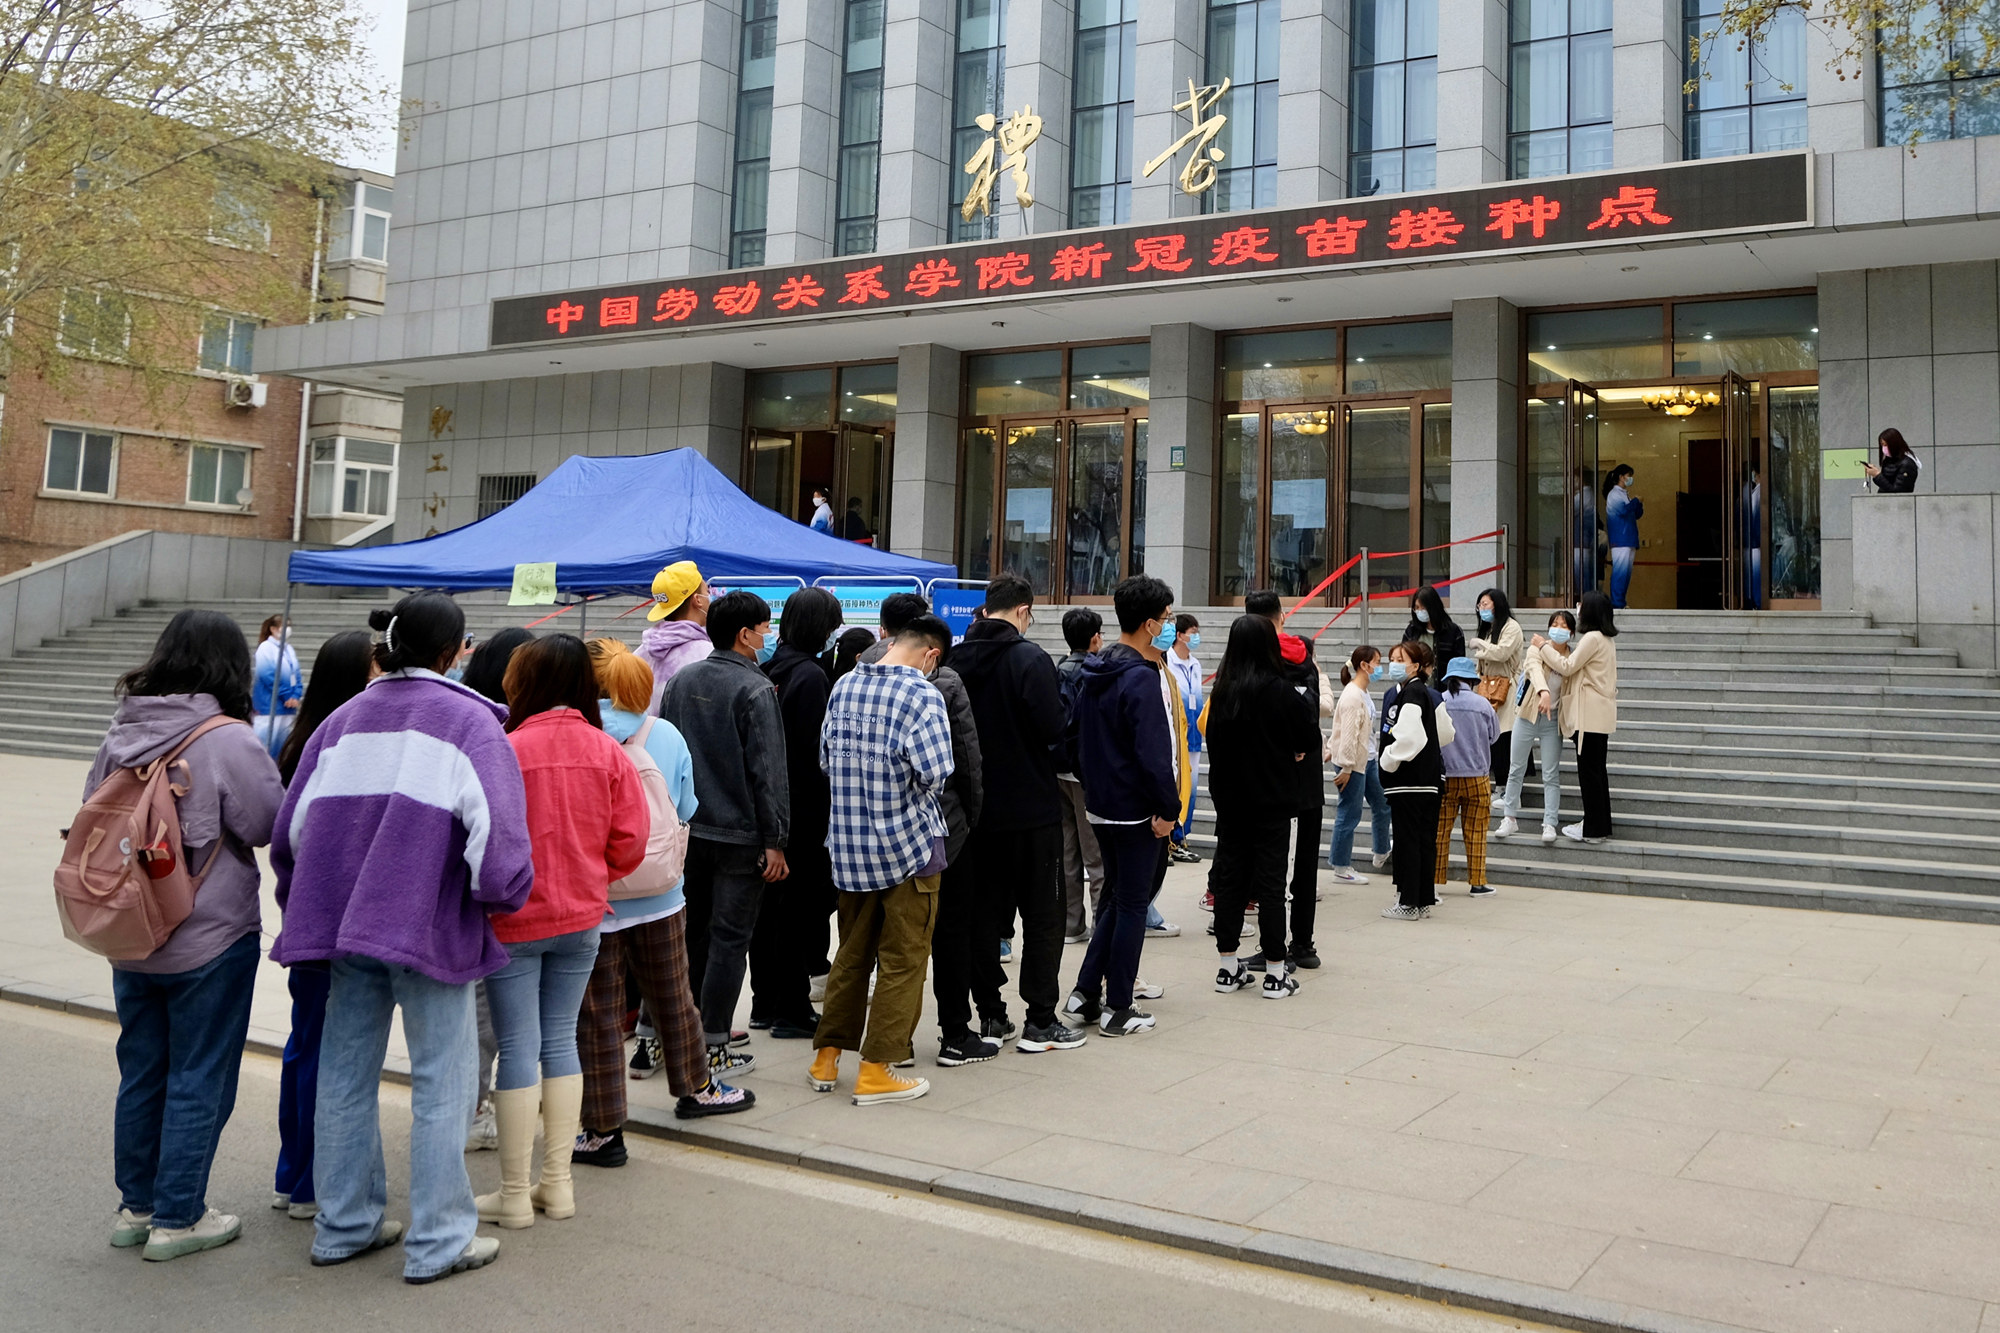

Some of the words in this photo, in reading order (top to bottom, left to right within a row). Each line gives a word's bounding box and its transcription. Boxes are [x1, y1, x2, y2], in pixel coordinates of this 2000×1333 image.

[546, 185, 1672, 333] 中国劳动关系学院新冠疫苗接种点
